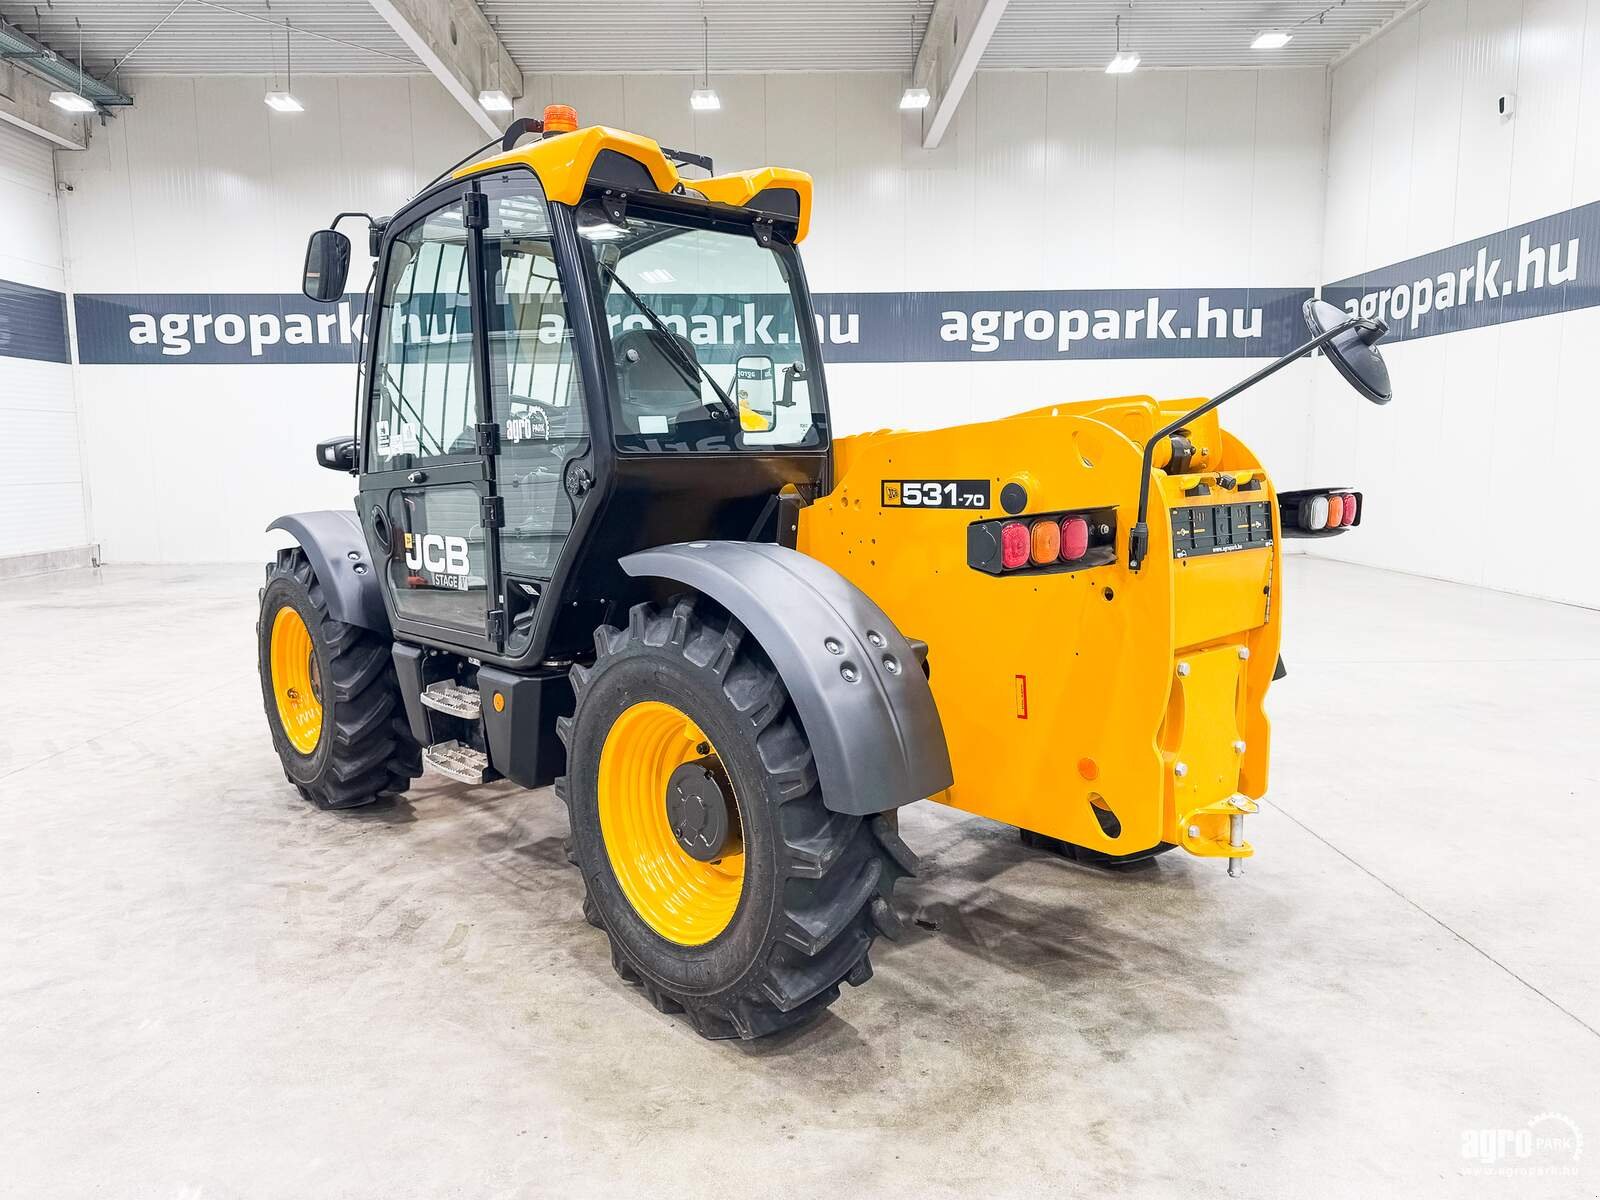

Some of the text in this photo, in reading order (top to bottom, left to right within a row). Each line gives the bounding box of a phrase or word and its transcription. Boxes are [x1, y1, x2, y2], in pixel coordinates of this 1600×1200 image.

[129, 302, 457, 356] agroparkhu
[940, 297, 1262, 352] agropark.hu
[506, 419, 531, 443] agro
[902, 482, 985, 506] 531-70
[405, 533, 470, 575] JCB
[435, 574, 458, 588] STAGE
